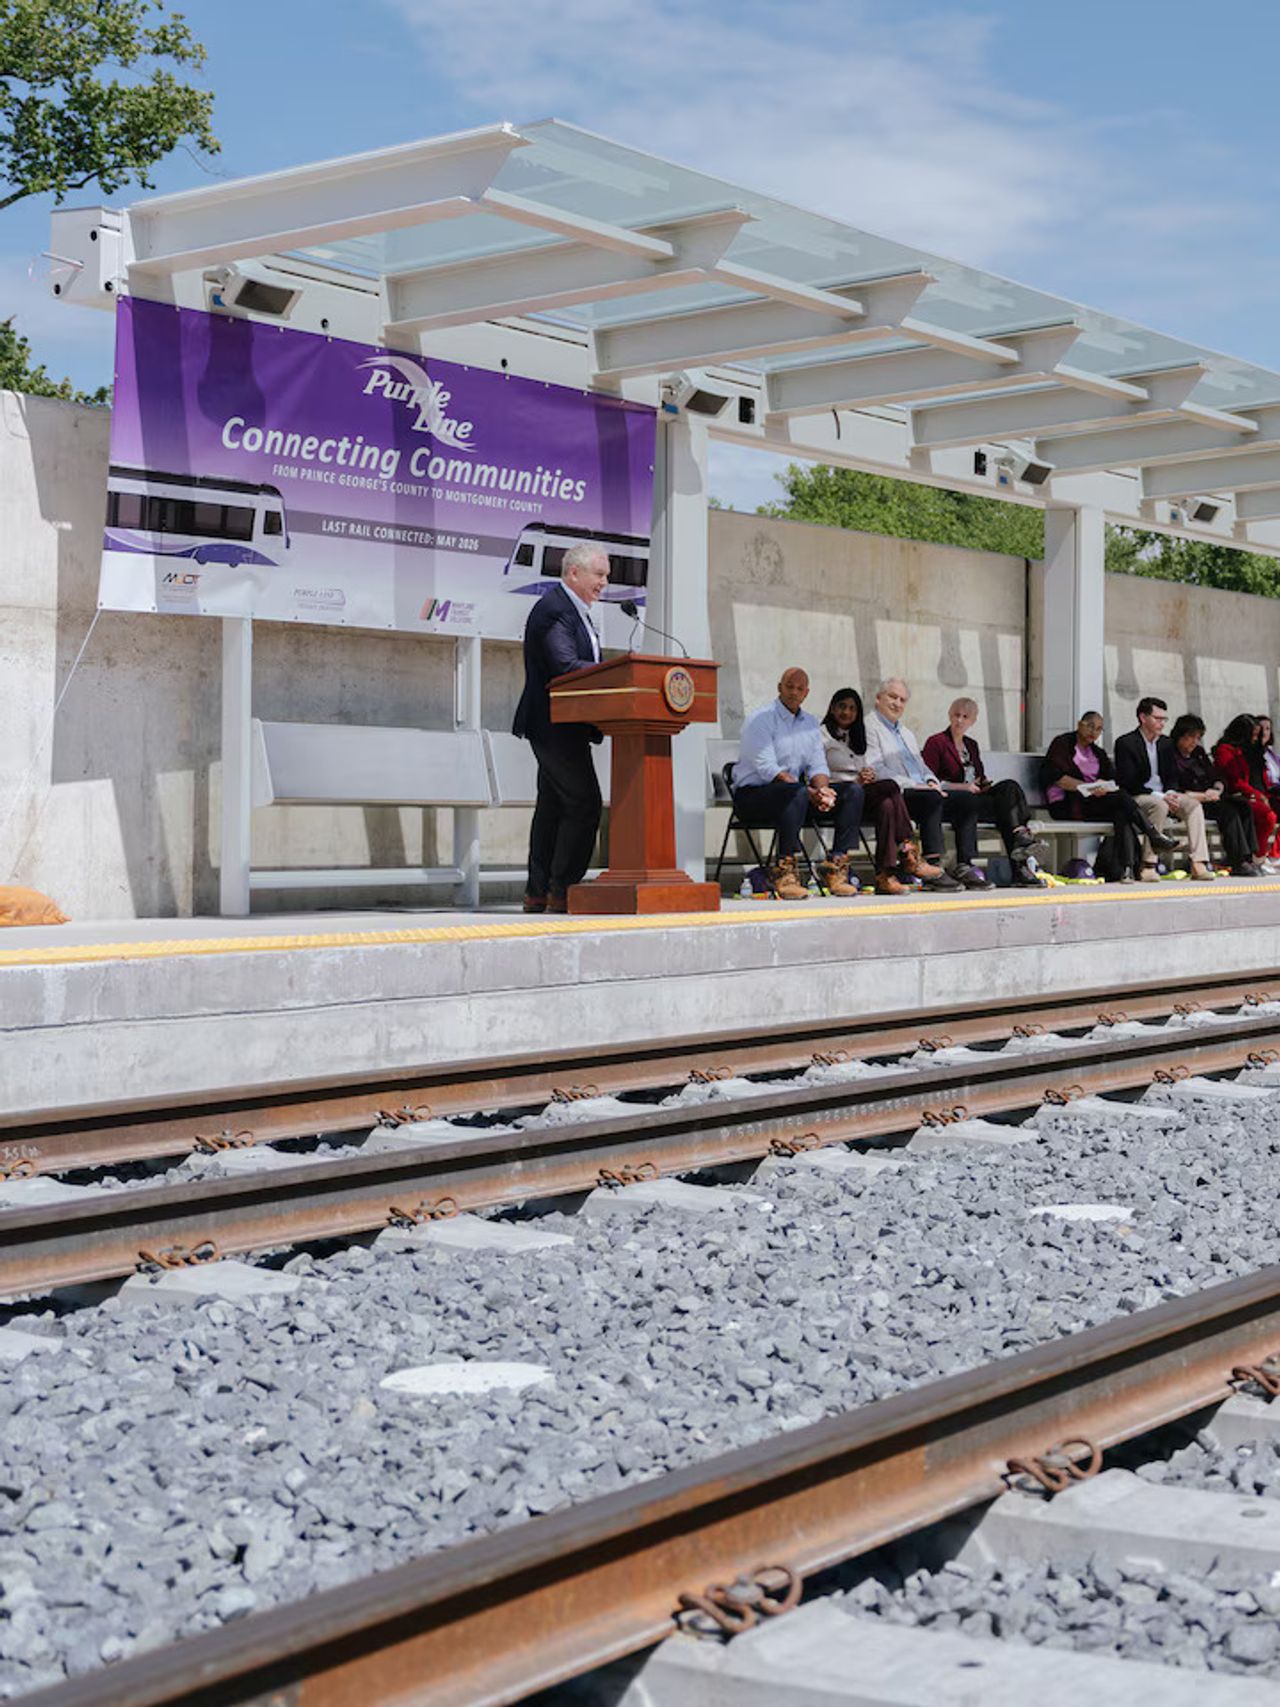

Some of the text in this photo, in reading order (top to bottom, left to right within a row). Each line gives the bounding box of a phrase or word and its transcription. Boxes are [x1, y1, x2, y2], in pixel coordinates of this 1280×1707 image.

[362, 369, 451, 409] Purple
[411, 410, 474, 439] Line
[221, 416, 587, 502] Connecting Communities
[272, 463, 543, 514] FROM PRINCE GEORGE'S COUNTY TO MONTGOMERY COUNTY
[321, 519, 479, 551] LAST RAIL CONNECTED: MAY 2026
